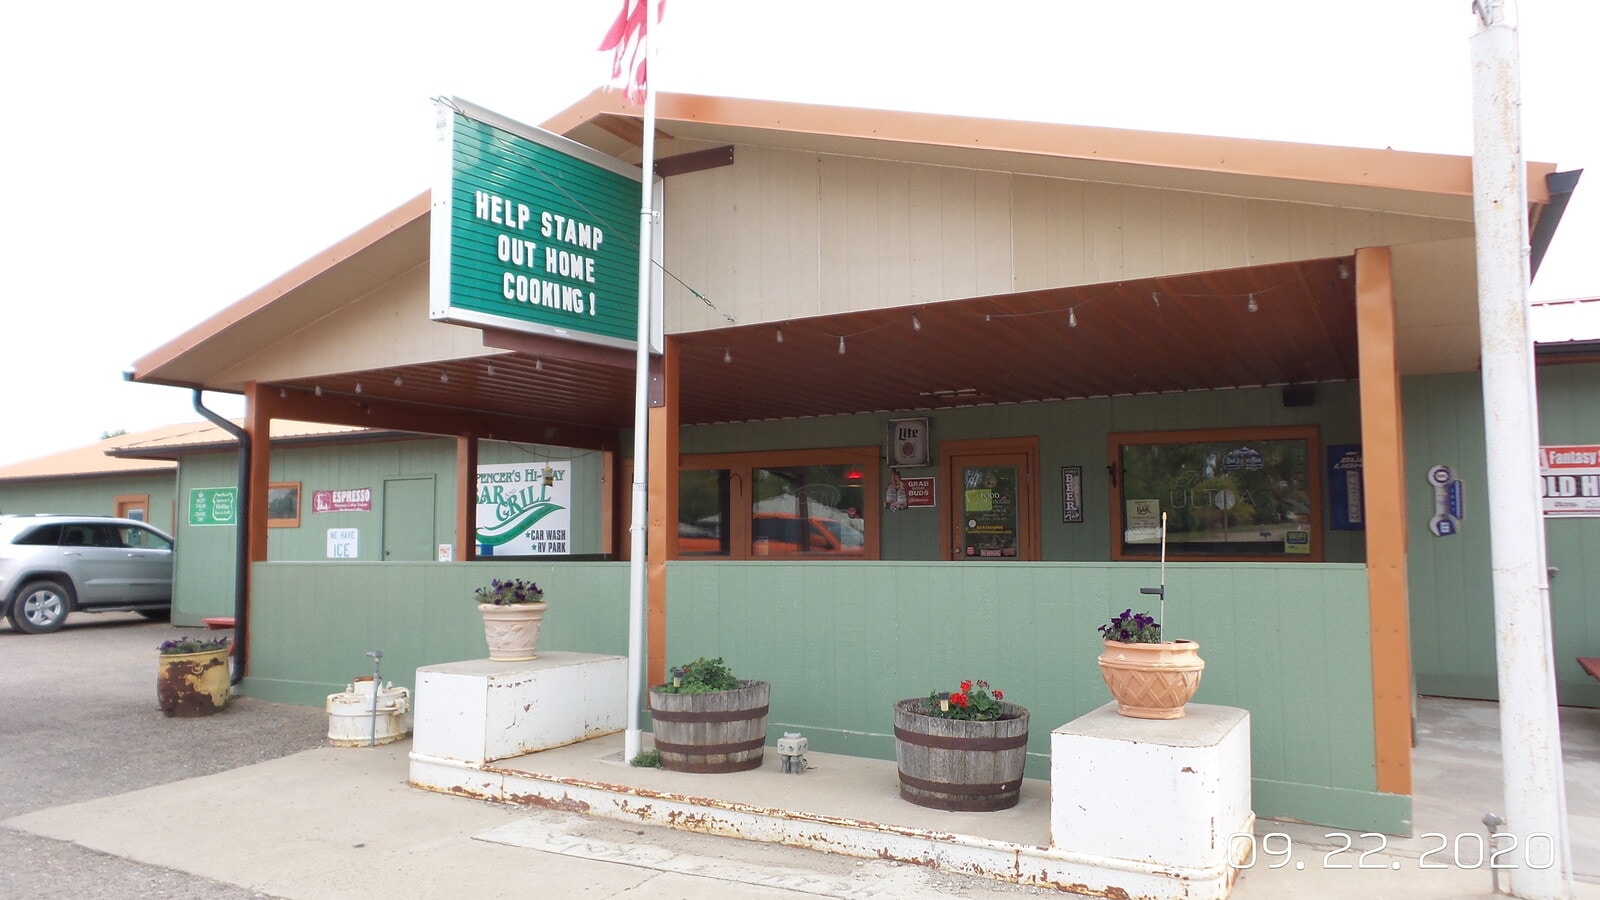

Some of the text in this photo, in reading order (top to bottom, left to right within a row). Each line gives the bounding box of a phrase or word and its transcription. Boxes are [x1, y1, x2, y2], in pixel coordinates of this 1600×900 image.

[475, 190, 603, 251] HELP STAMP
[497, 234, 596, 283] OUT HOME
[502, 272, 584, 314] COOKING
[898, 427, 919, 441] Lite
[1549, 450, 1597, 465] Fantasy
[477, 469, 521, 484] PENCER'S
[332, 489, 370, 503] ESPRESSO
[476, 484, 508, 505] AR
[1064, 473, 1077, 511] BEER
[496, 485, 551, 521] GRILL
[330, 530, 355, 539] WE HAVE
[530, 529, 544, 541] CAR
[546, 529, 566, 541] WASH
[333, 542, 350, 557] ICE
[537, 541, 566, 553] RV PARK
